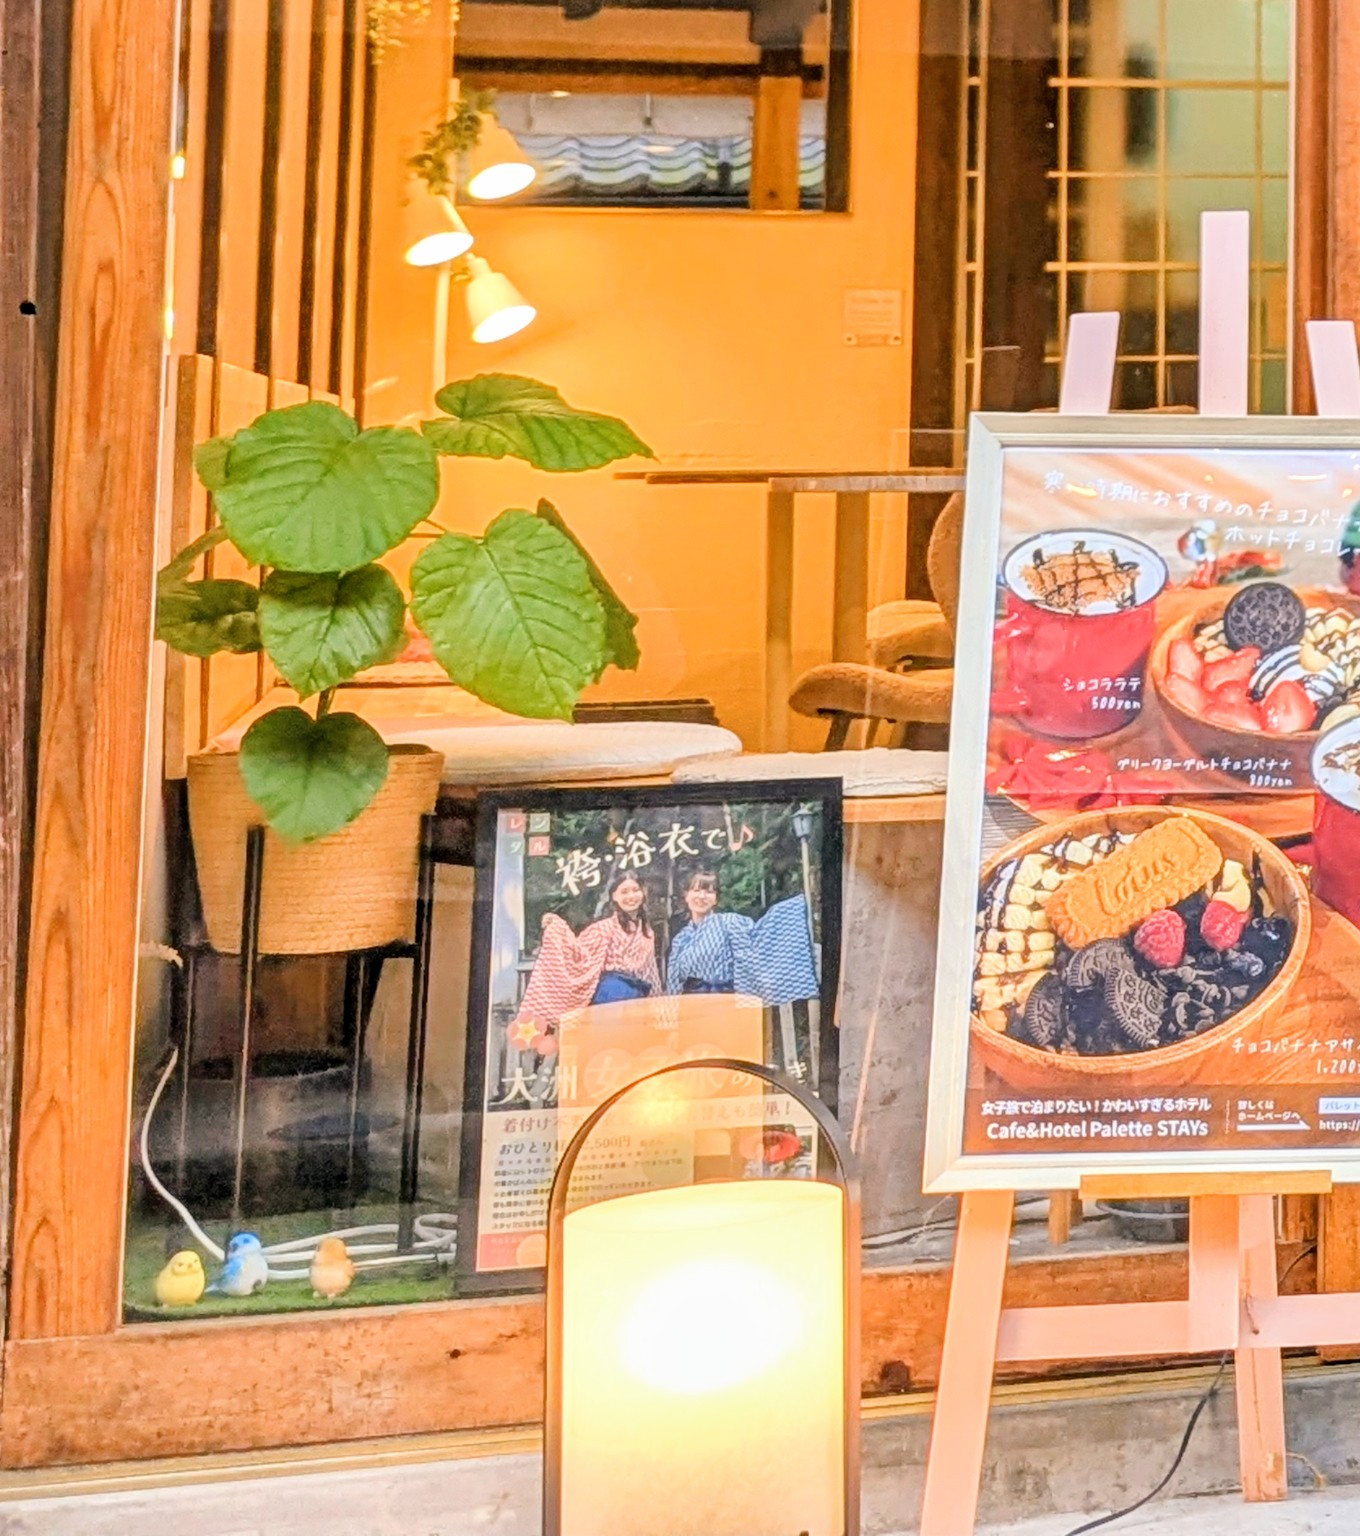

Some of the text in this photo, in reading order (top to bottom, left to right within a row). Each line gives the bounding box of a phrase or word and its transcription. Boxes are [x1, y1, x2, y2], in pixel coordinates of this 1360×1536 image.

[1062, 677, 1142, 693] ショコララテ
[1091, 696, 1142, 710] 500yen
[987, 1119, 1208, 1140] Cafe&Hotel Palette STAYs
